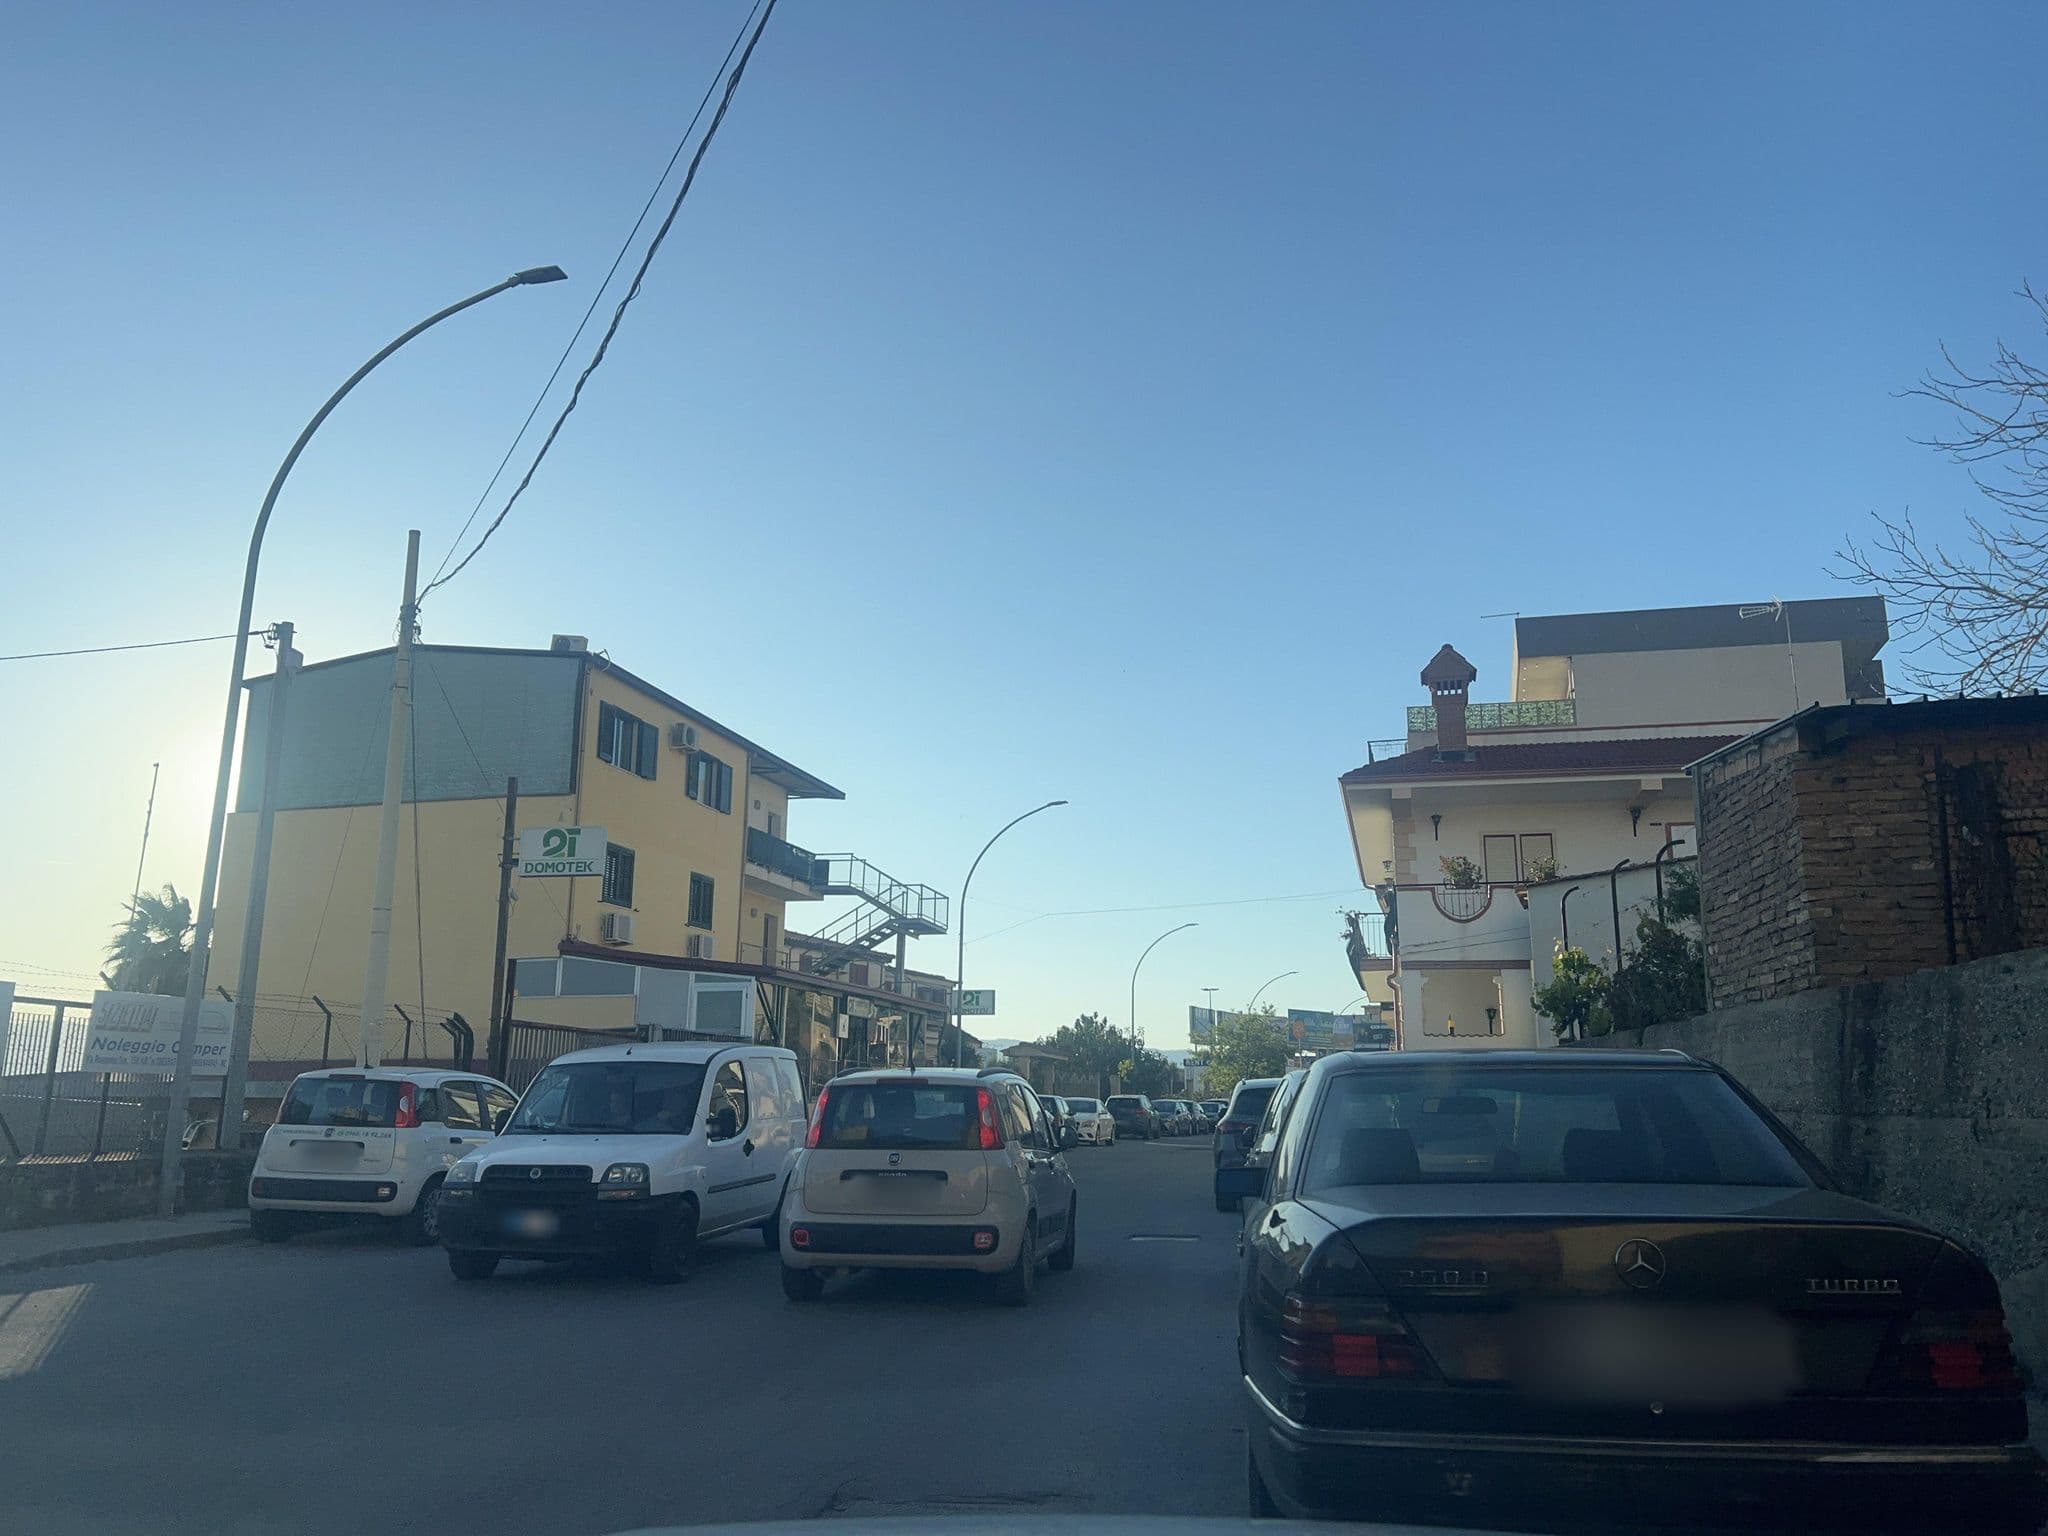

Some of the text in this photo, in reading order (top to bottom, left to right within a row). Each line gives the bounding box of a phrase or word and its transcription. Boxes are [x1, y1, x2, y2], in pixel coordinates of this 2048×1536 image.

[524, 861, 594, 874] DOMOTEK
[91, 1038, 226, 1056] Noleggio Cmper
[1805, 1278, 1898, 1292] TURBO
